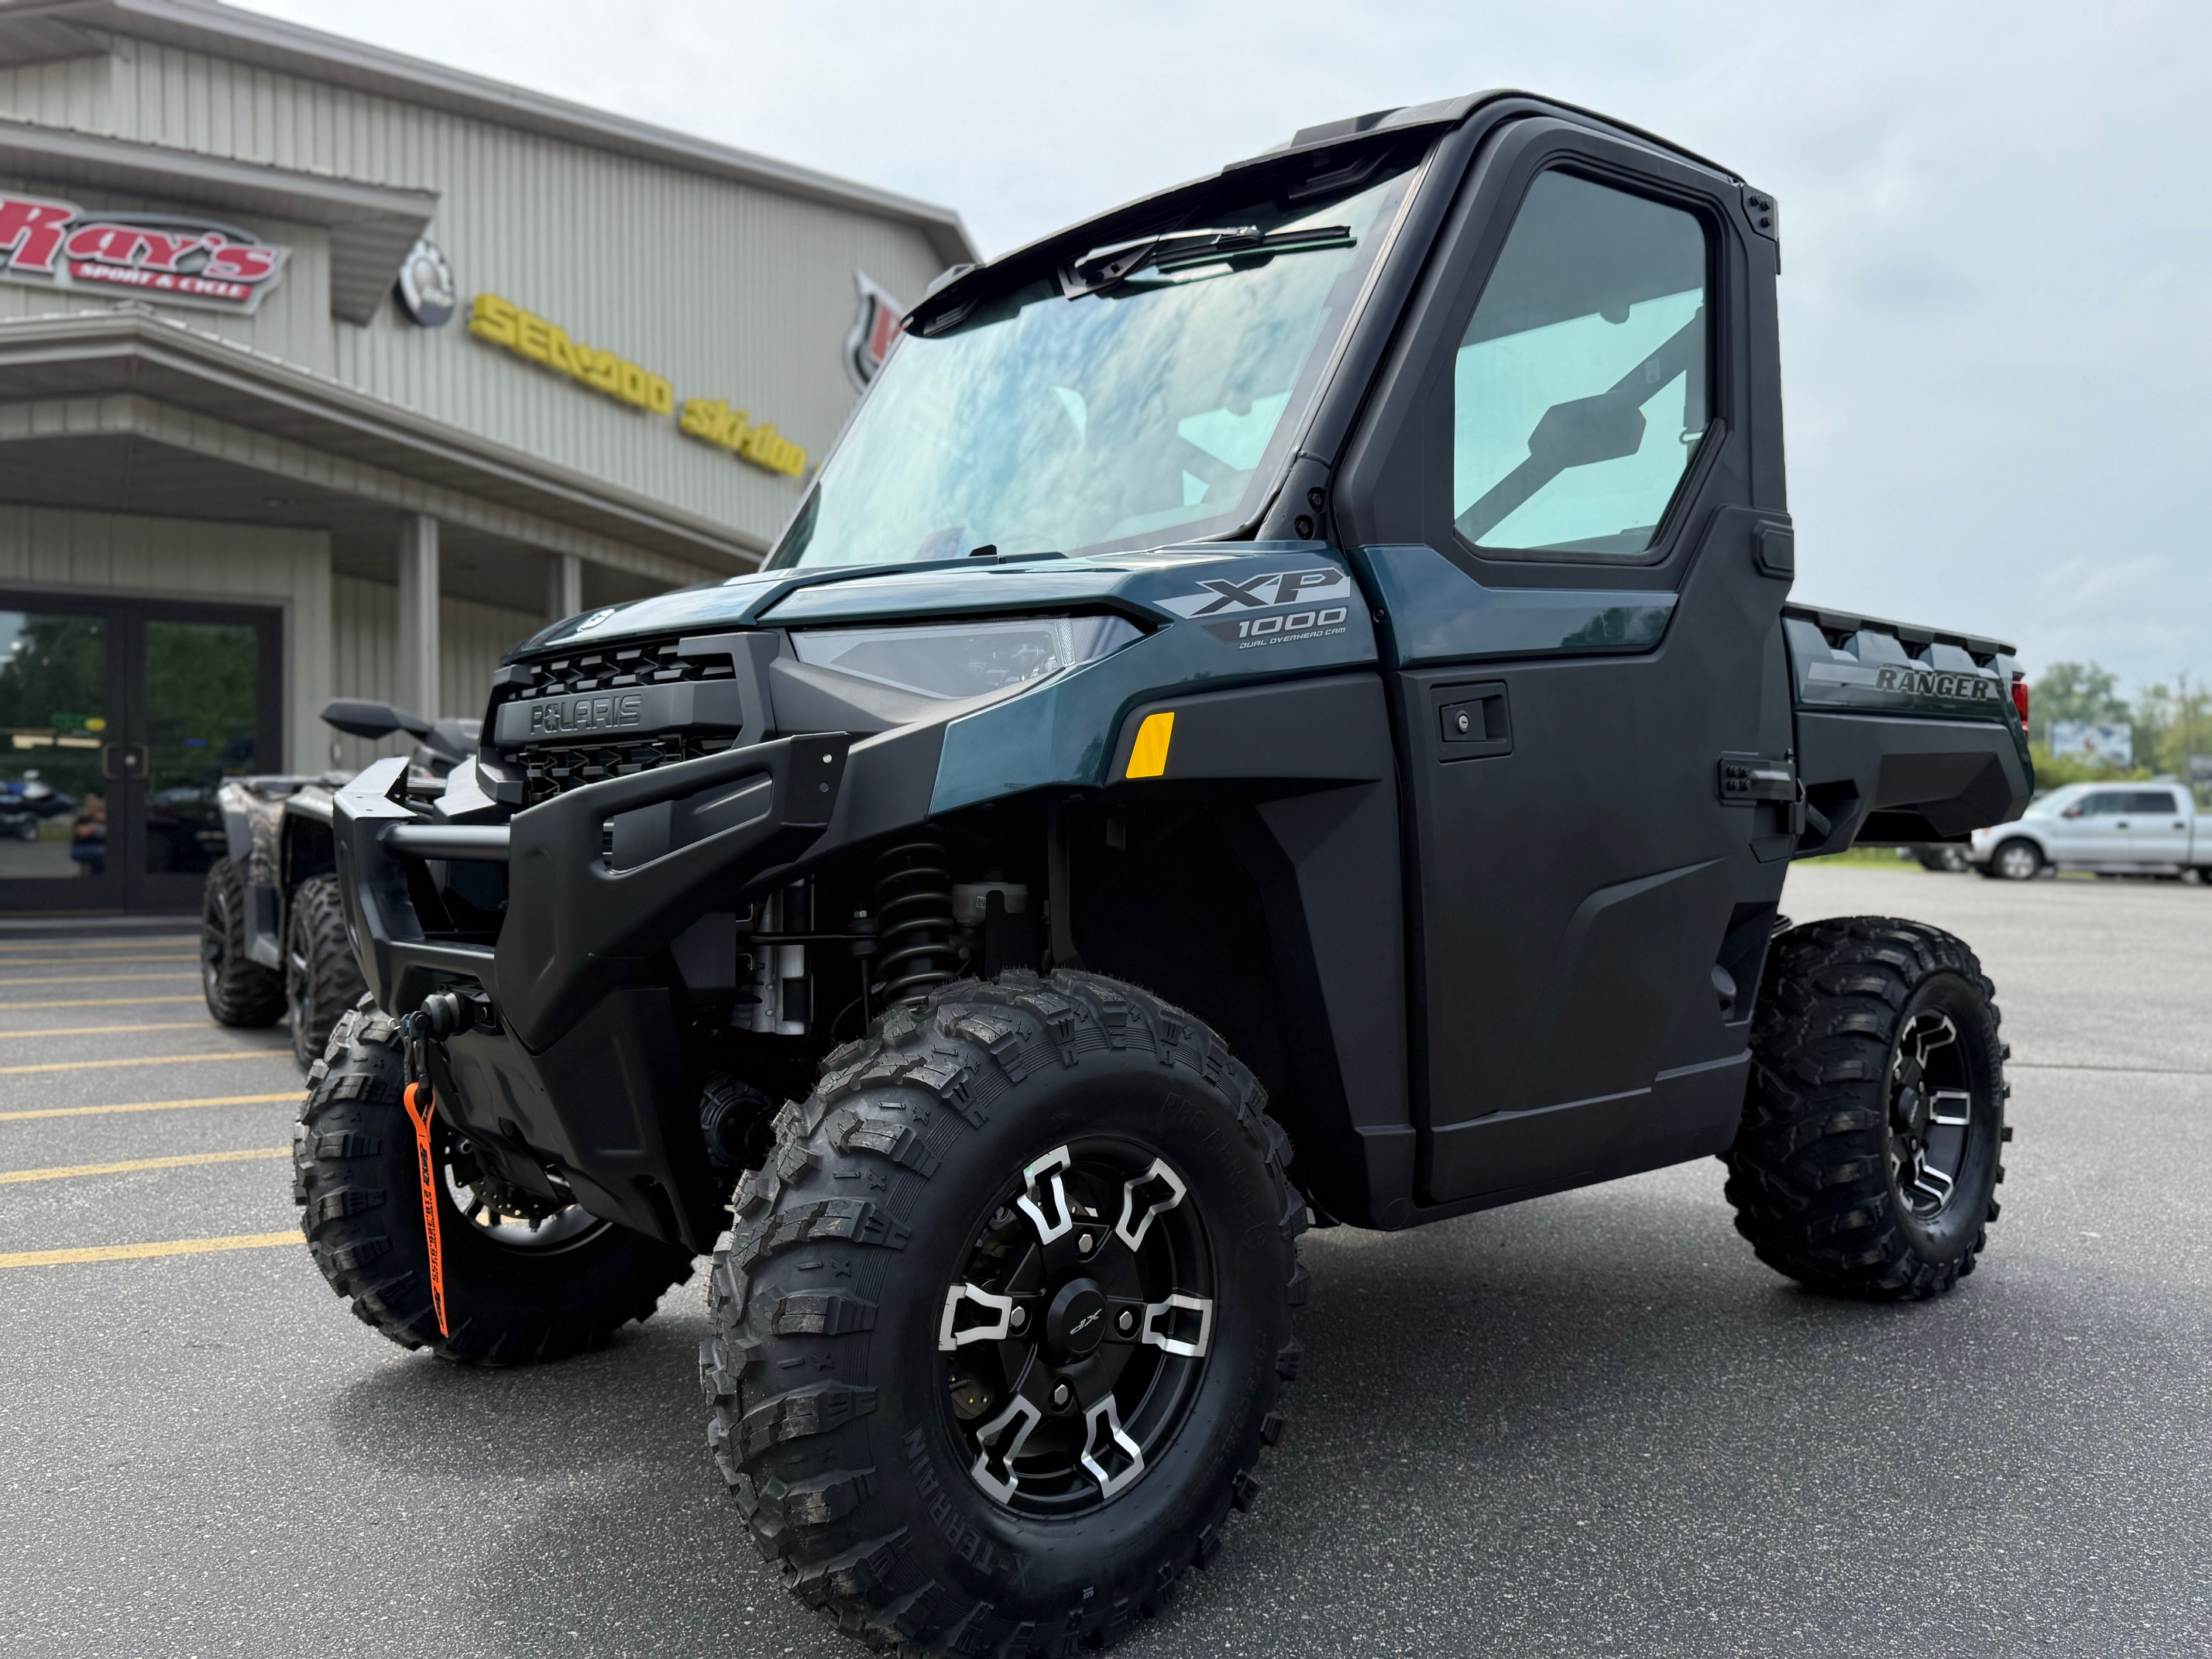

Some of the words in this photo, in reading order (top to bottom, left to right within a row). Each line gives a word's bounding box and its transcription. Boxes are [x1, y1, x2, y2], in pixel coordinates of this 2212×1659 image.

[79, 263, 153, 290] SPORT
[156, 273, 174, 290] &
[178, 276, 245, 299] CYCLE
[1190, 566, 1348, 619] XP
[1239, 606, 1348, 638] 1000
[1239, 640, 1267, 650] DUAL
[1270, 630, 1324, 644] OVERHEAD
[1324, 627, 1347, 636] CAM
[1874, 666, 1990, 702] RANGER
[530, 693, 643, 736] POLARIS
[1069, 1307, 1103, 1335] XP
[902, 1422, 1034, 1590] X-TERRAIN
